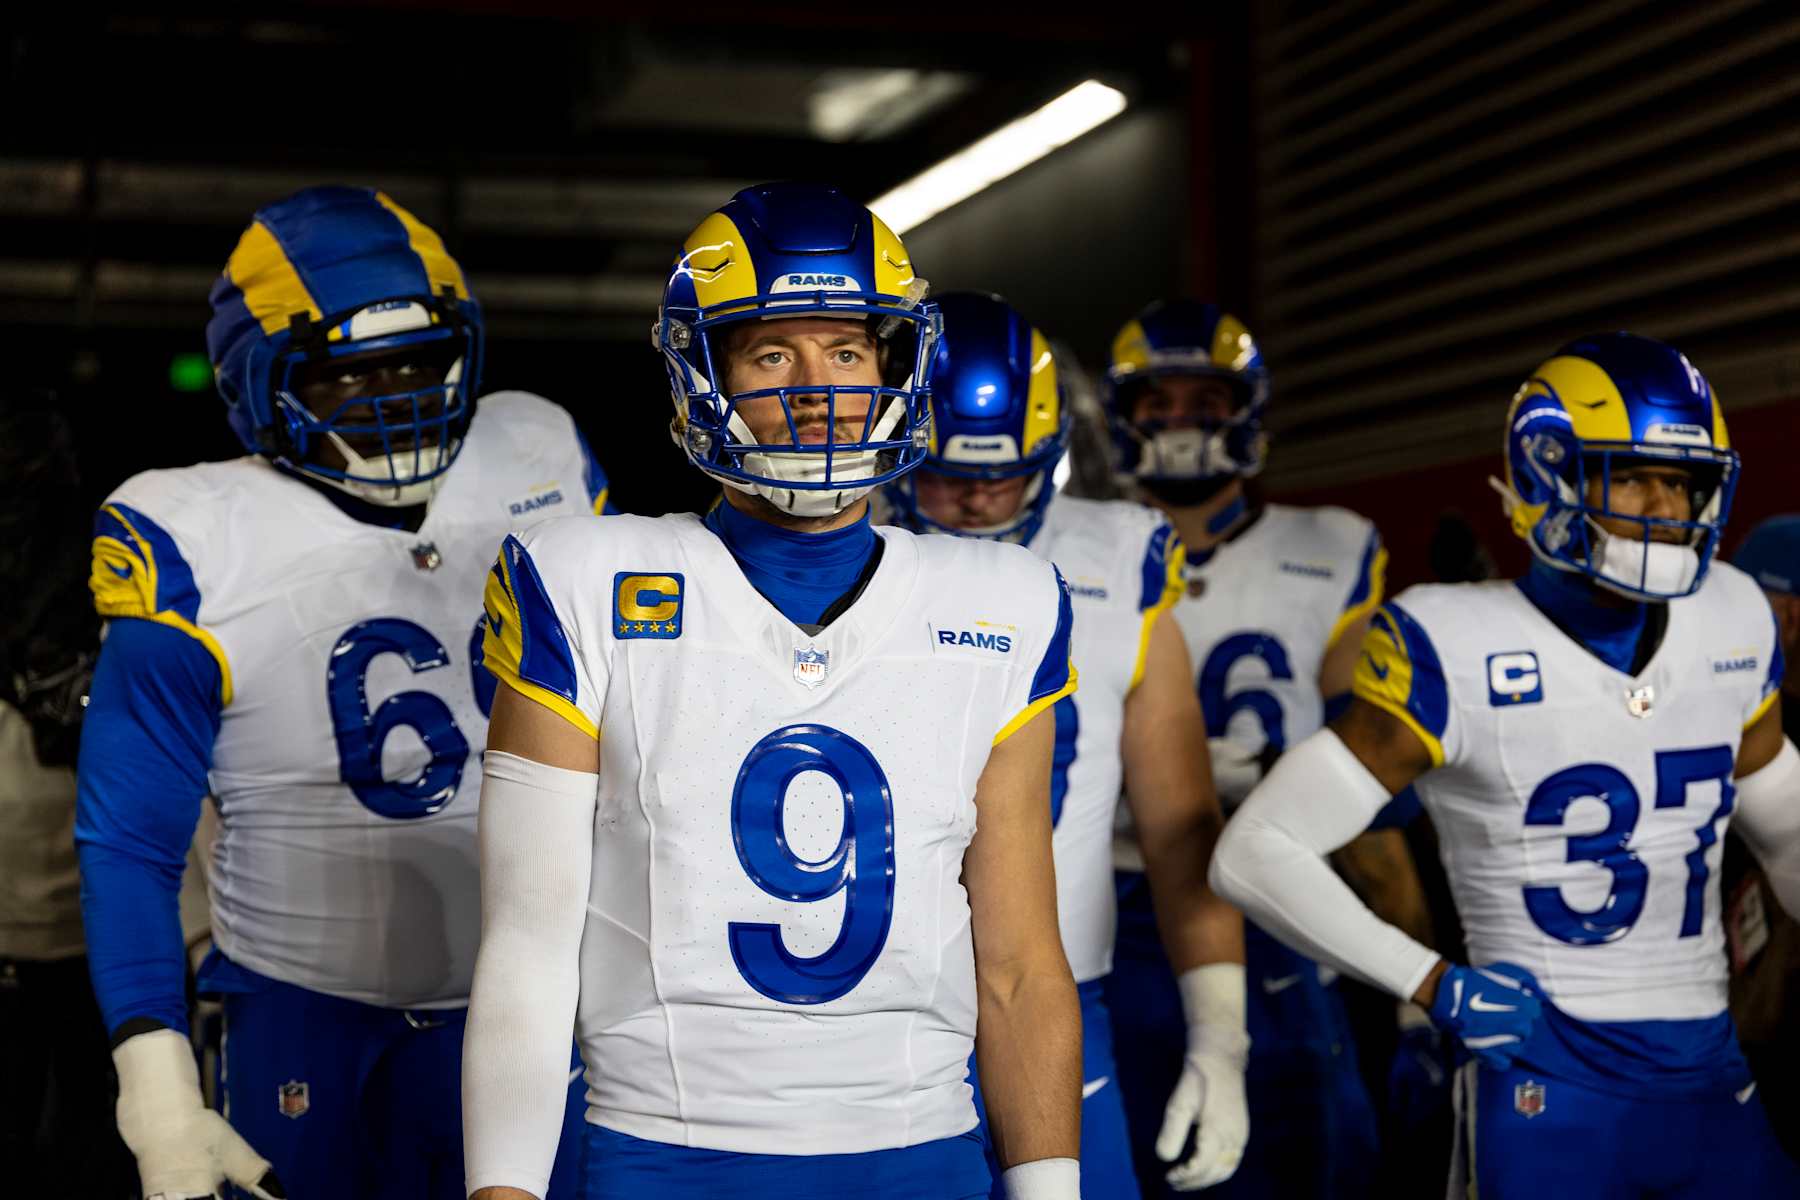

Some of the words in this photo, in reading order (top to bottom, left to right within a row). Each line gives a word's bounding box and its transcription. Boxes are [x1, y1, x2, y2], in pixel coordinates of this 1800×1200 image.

[787, 275, 847, 287] RAMS
[509, 489, 563, 516] RAMS
[618, 575, 680, 621] C
[938, 629, 1012, 653] RAMS
[1490, 654, 1538, 695] C
[1713, 655, 1758, 673] RAMS
[326, 615, 500, 822] 6
[727, 722, 896, 1006] 9
[1520, 743, 1737, 946] 37
